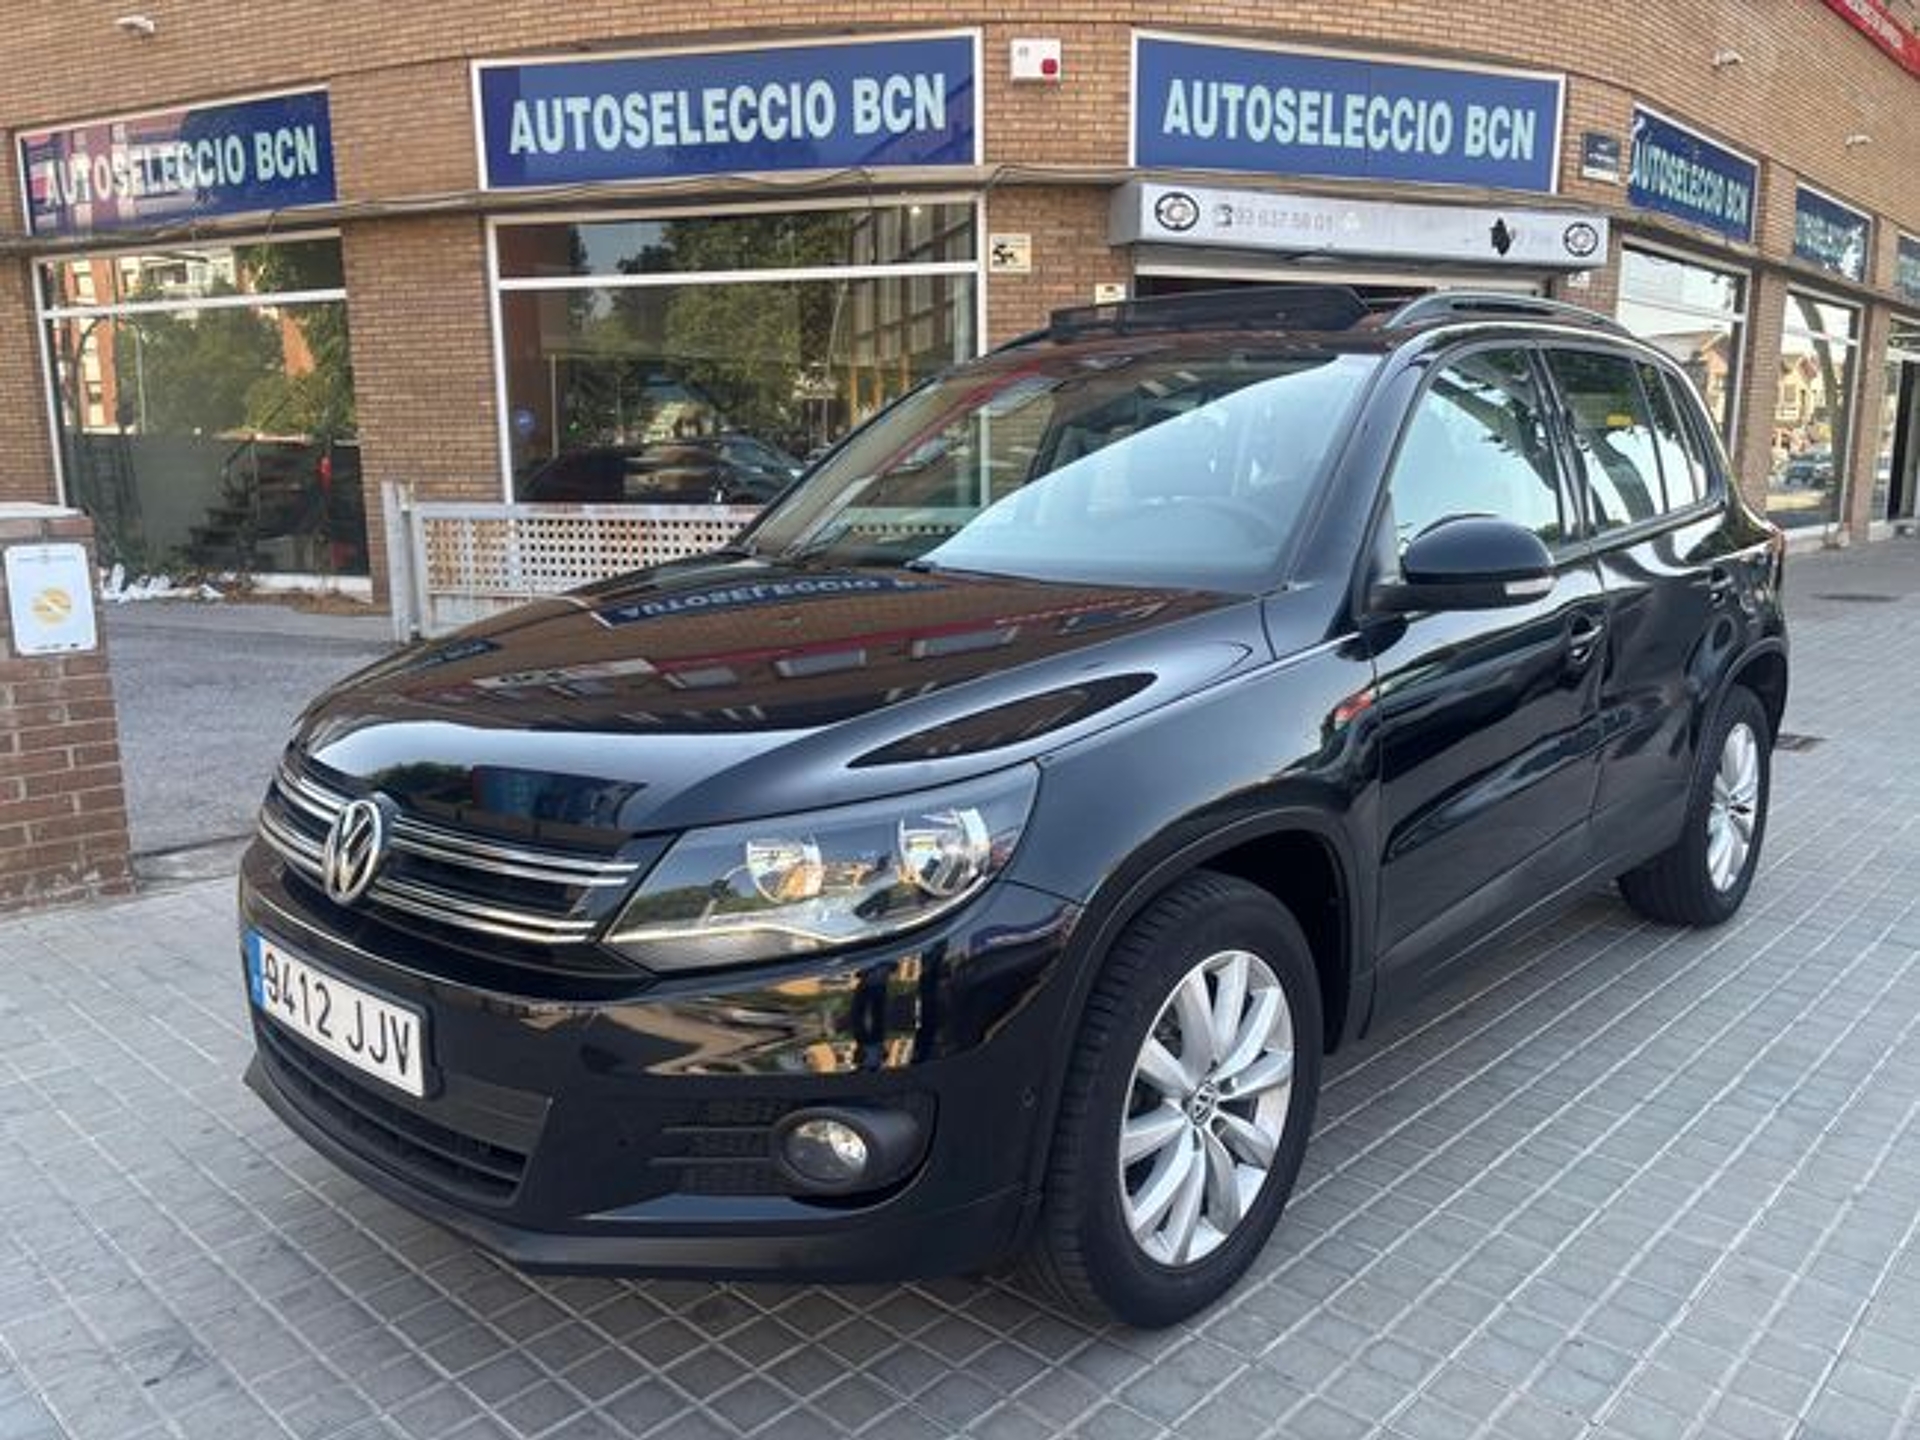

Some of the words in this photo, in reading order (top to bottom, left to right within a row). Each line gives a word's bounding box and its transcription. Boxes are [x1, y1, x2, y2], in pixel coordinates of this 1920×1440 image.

[510, 79, 836, 155] AUTOSELECCIO
[852, 73, 946, 134] BCN
[1162, 78, 1453, 156] AUTOSELECCIO
[1463, 104, 1537, 161] BCN
[45, 133, 247, 206] AUTOSELECCIO
[253, 124, 319, 181] BCN
[1629, 140, 1724, 217] AUTOSELECCIO
[265, 952, 333, 1039] 9412
[346, 1000, 410, 1077] JJV
